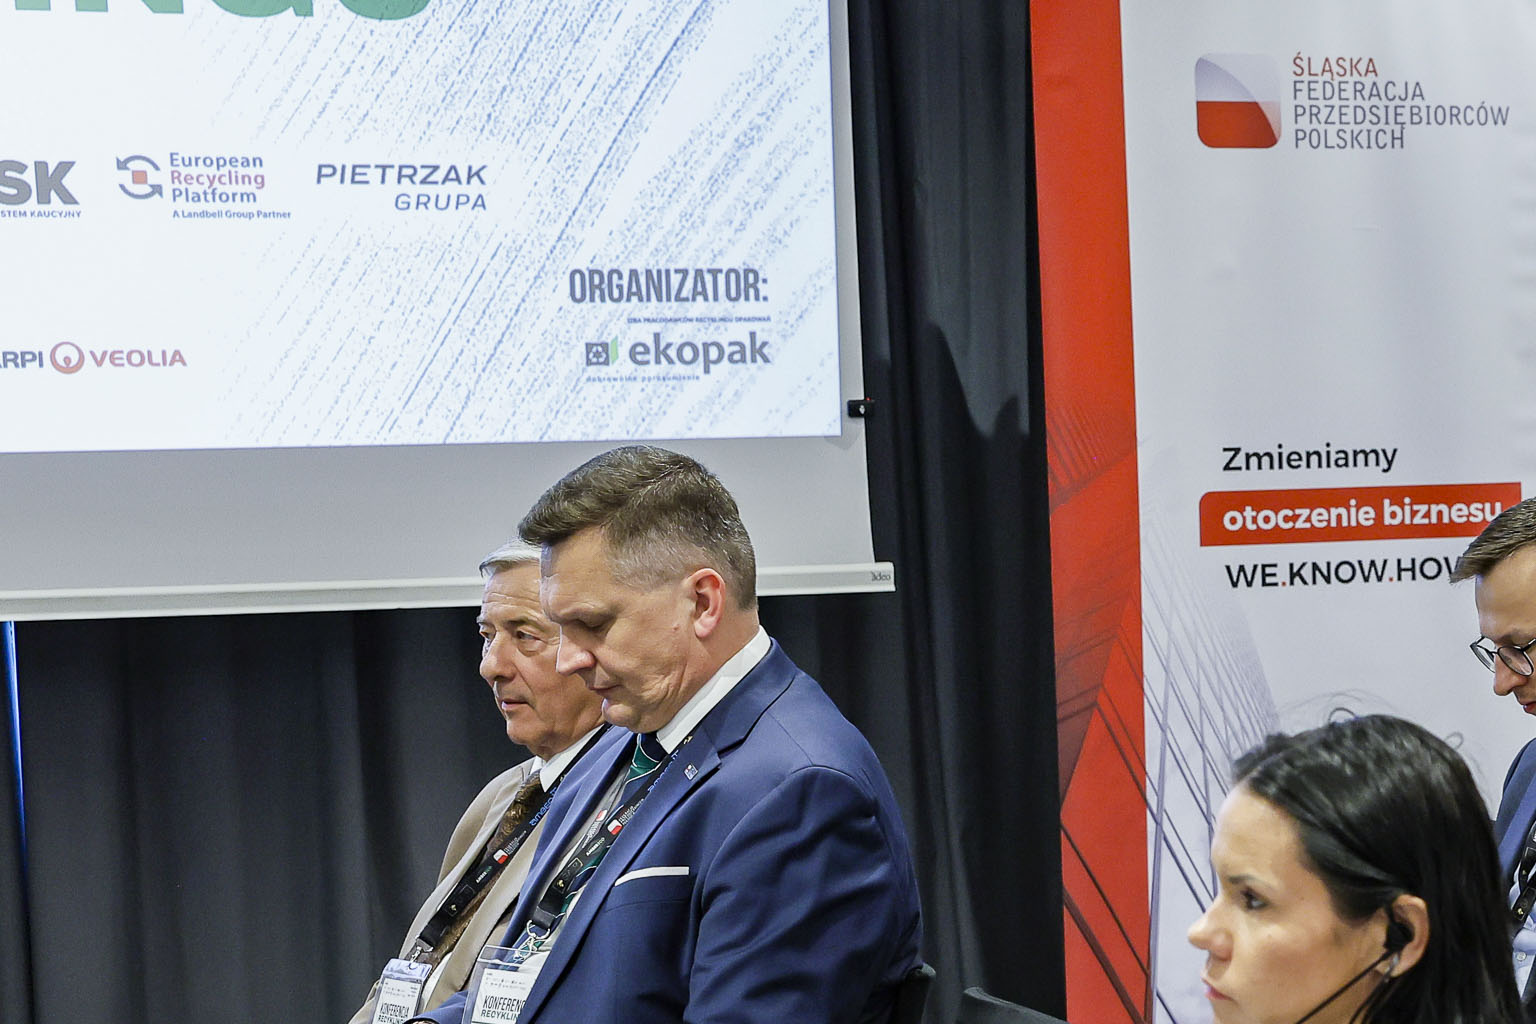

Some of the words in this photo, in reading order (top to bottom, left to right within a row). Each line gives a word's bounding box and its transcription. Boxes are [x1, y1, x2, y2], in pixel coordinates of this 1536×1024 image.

[1292, 51, 1379, 81] ŚLĄSKA
[1293, 80, 1426, 101] FEDERACJA
[1294, 101, 1511, 130] PRZEDSIĘBIORCÓW
[1295, 128, 1406, 149] POLSKICH
[169, 152, 264, 171] European
[170, 170, 266, 189] Recycling
[316, 163, 488, 186] PIETRZAK
[172, 187, 257, 203] Platform
[394, 193, 487, 211] GRUPA
[30, 210, 82, 218] KAUCYJNY
[172, 210, 180, 219] A
[181, 210, 223, 219] Landbell
[225, 210, 255, 220] Group
[256, 210, 292, 219] Partner
[568, 267, 769, 304] ORGANIZATOR:
[0, 350, 44, 369] RPI
[89, 349, 188, 368] VEOLIA
[628, 331, 772, 375] ekopak
[1222, 442, 1399, 473] Zmieniamy
[1223, 498, 1376, 532] otoczenie
[1383, 497, 1503, 526] biznesu
[483, 995, 527, 1013] KONFERENC
[481, 1009, 519, 1021] RECYKLIN
